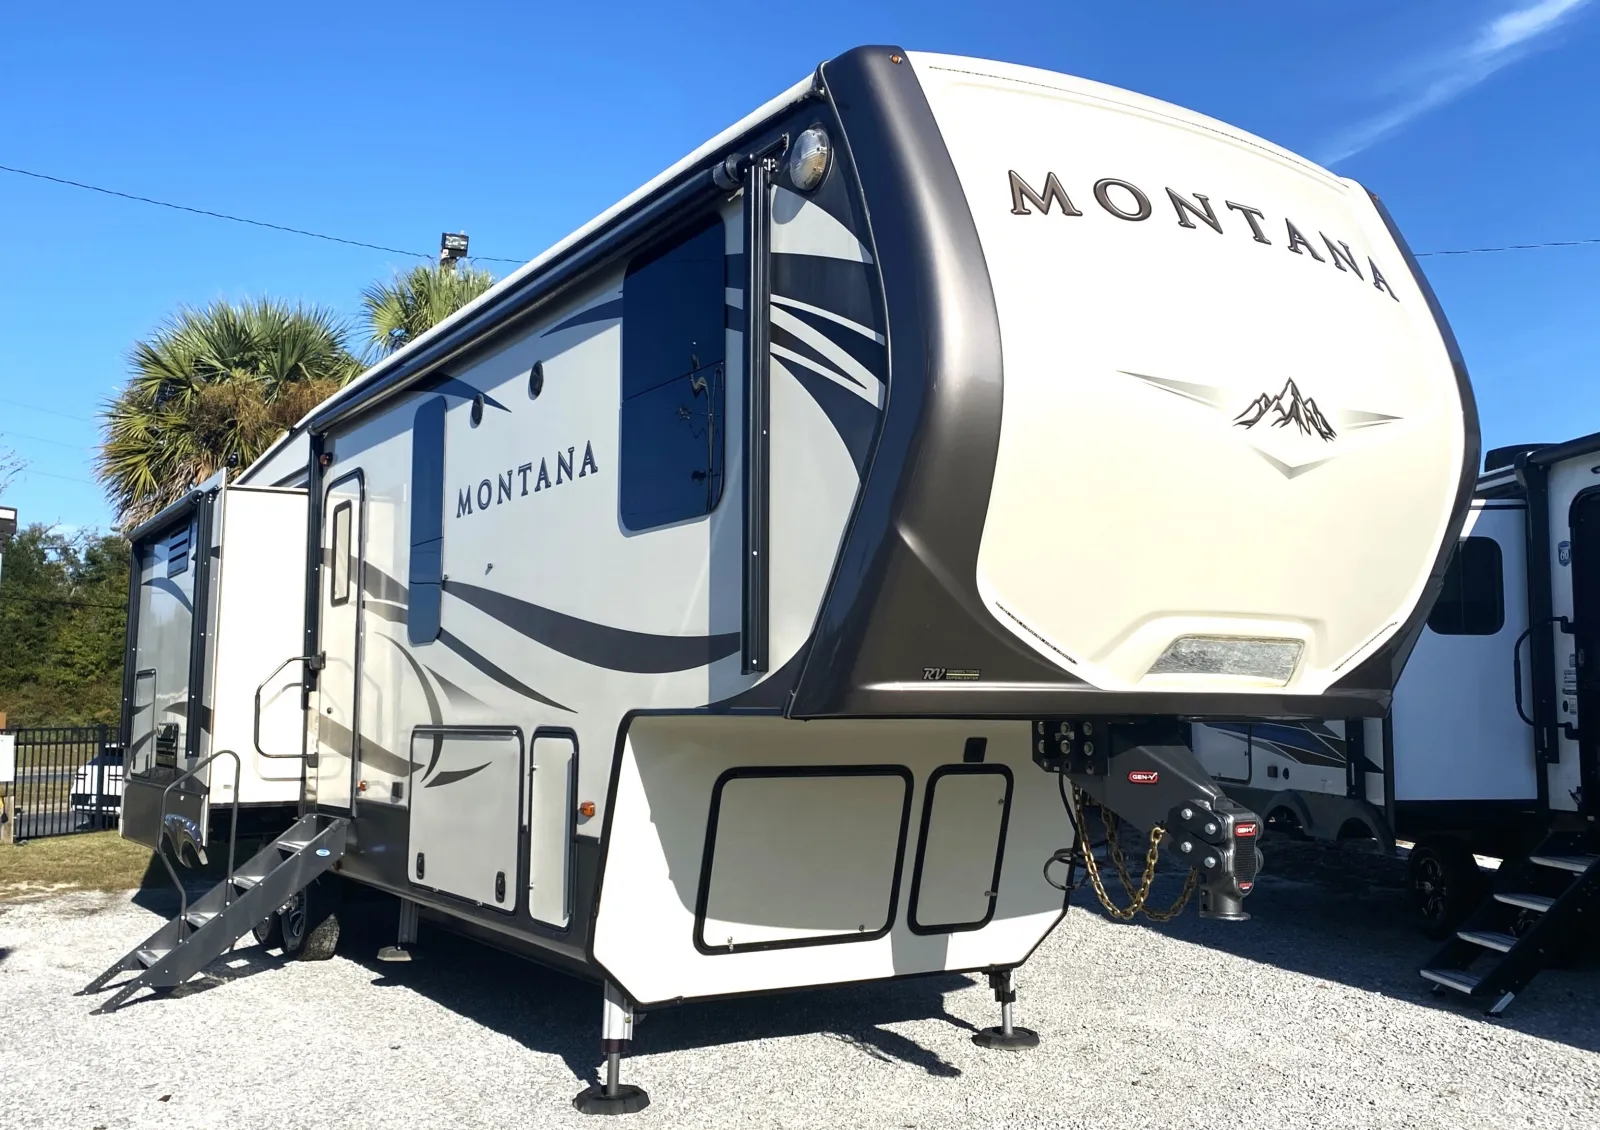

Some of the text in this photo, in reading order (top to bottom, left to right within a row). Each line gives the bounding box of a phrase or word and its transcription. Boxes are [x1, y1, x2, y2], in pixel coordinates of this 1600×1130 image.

[1008, 169, 1400, 302] MONTANA
[456, 440, 598, 518] MONTANA
[923, 667, 946, 680] RV
[1132, 772, 1158, 780] GEN-Y
